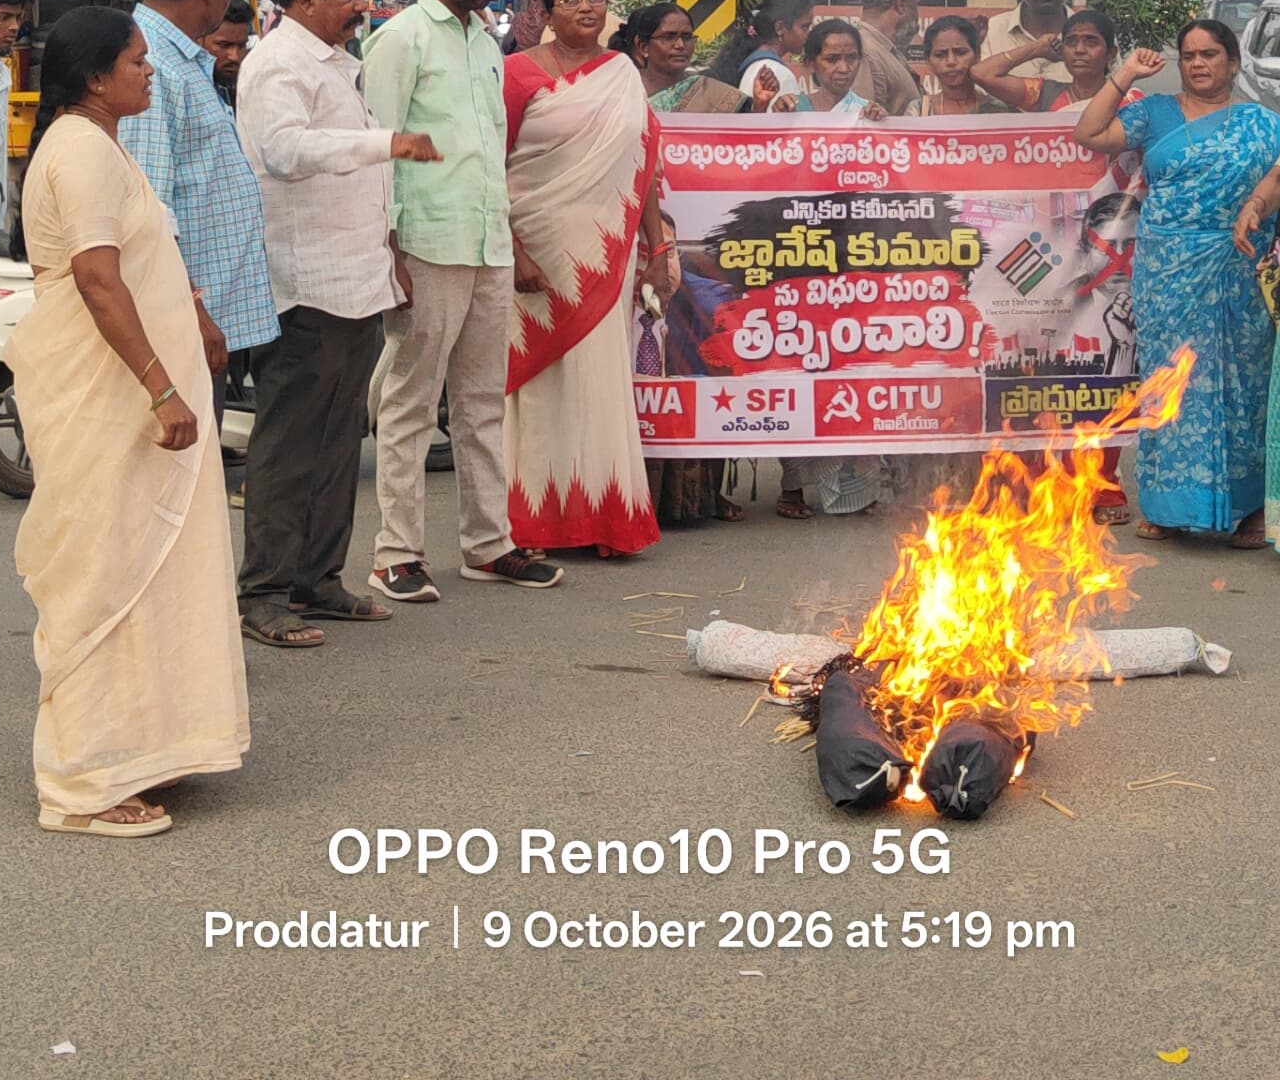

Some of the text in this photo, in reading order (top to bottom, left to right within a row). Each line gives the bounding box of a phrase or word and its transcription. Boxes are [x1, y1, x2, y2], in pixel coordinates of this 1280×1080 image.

[810, 135, 911, 173] ప్రజాతంత్ర
[917, 136, 1008, 166] మహిళా
[782, 198, 848, 225] ఎన్నికల
[719, 224, 982, 287] జ్ఞానేష్ కుమార్
[774, 273, 950, 310] ను విధుల నుంచి
[745, 387, 796, 412] SFI
[867, 384, 942, 412] CITU
